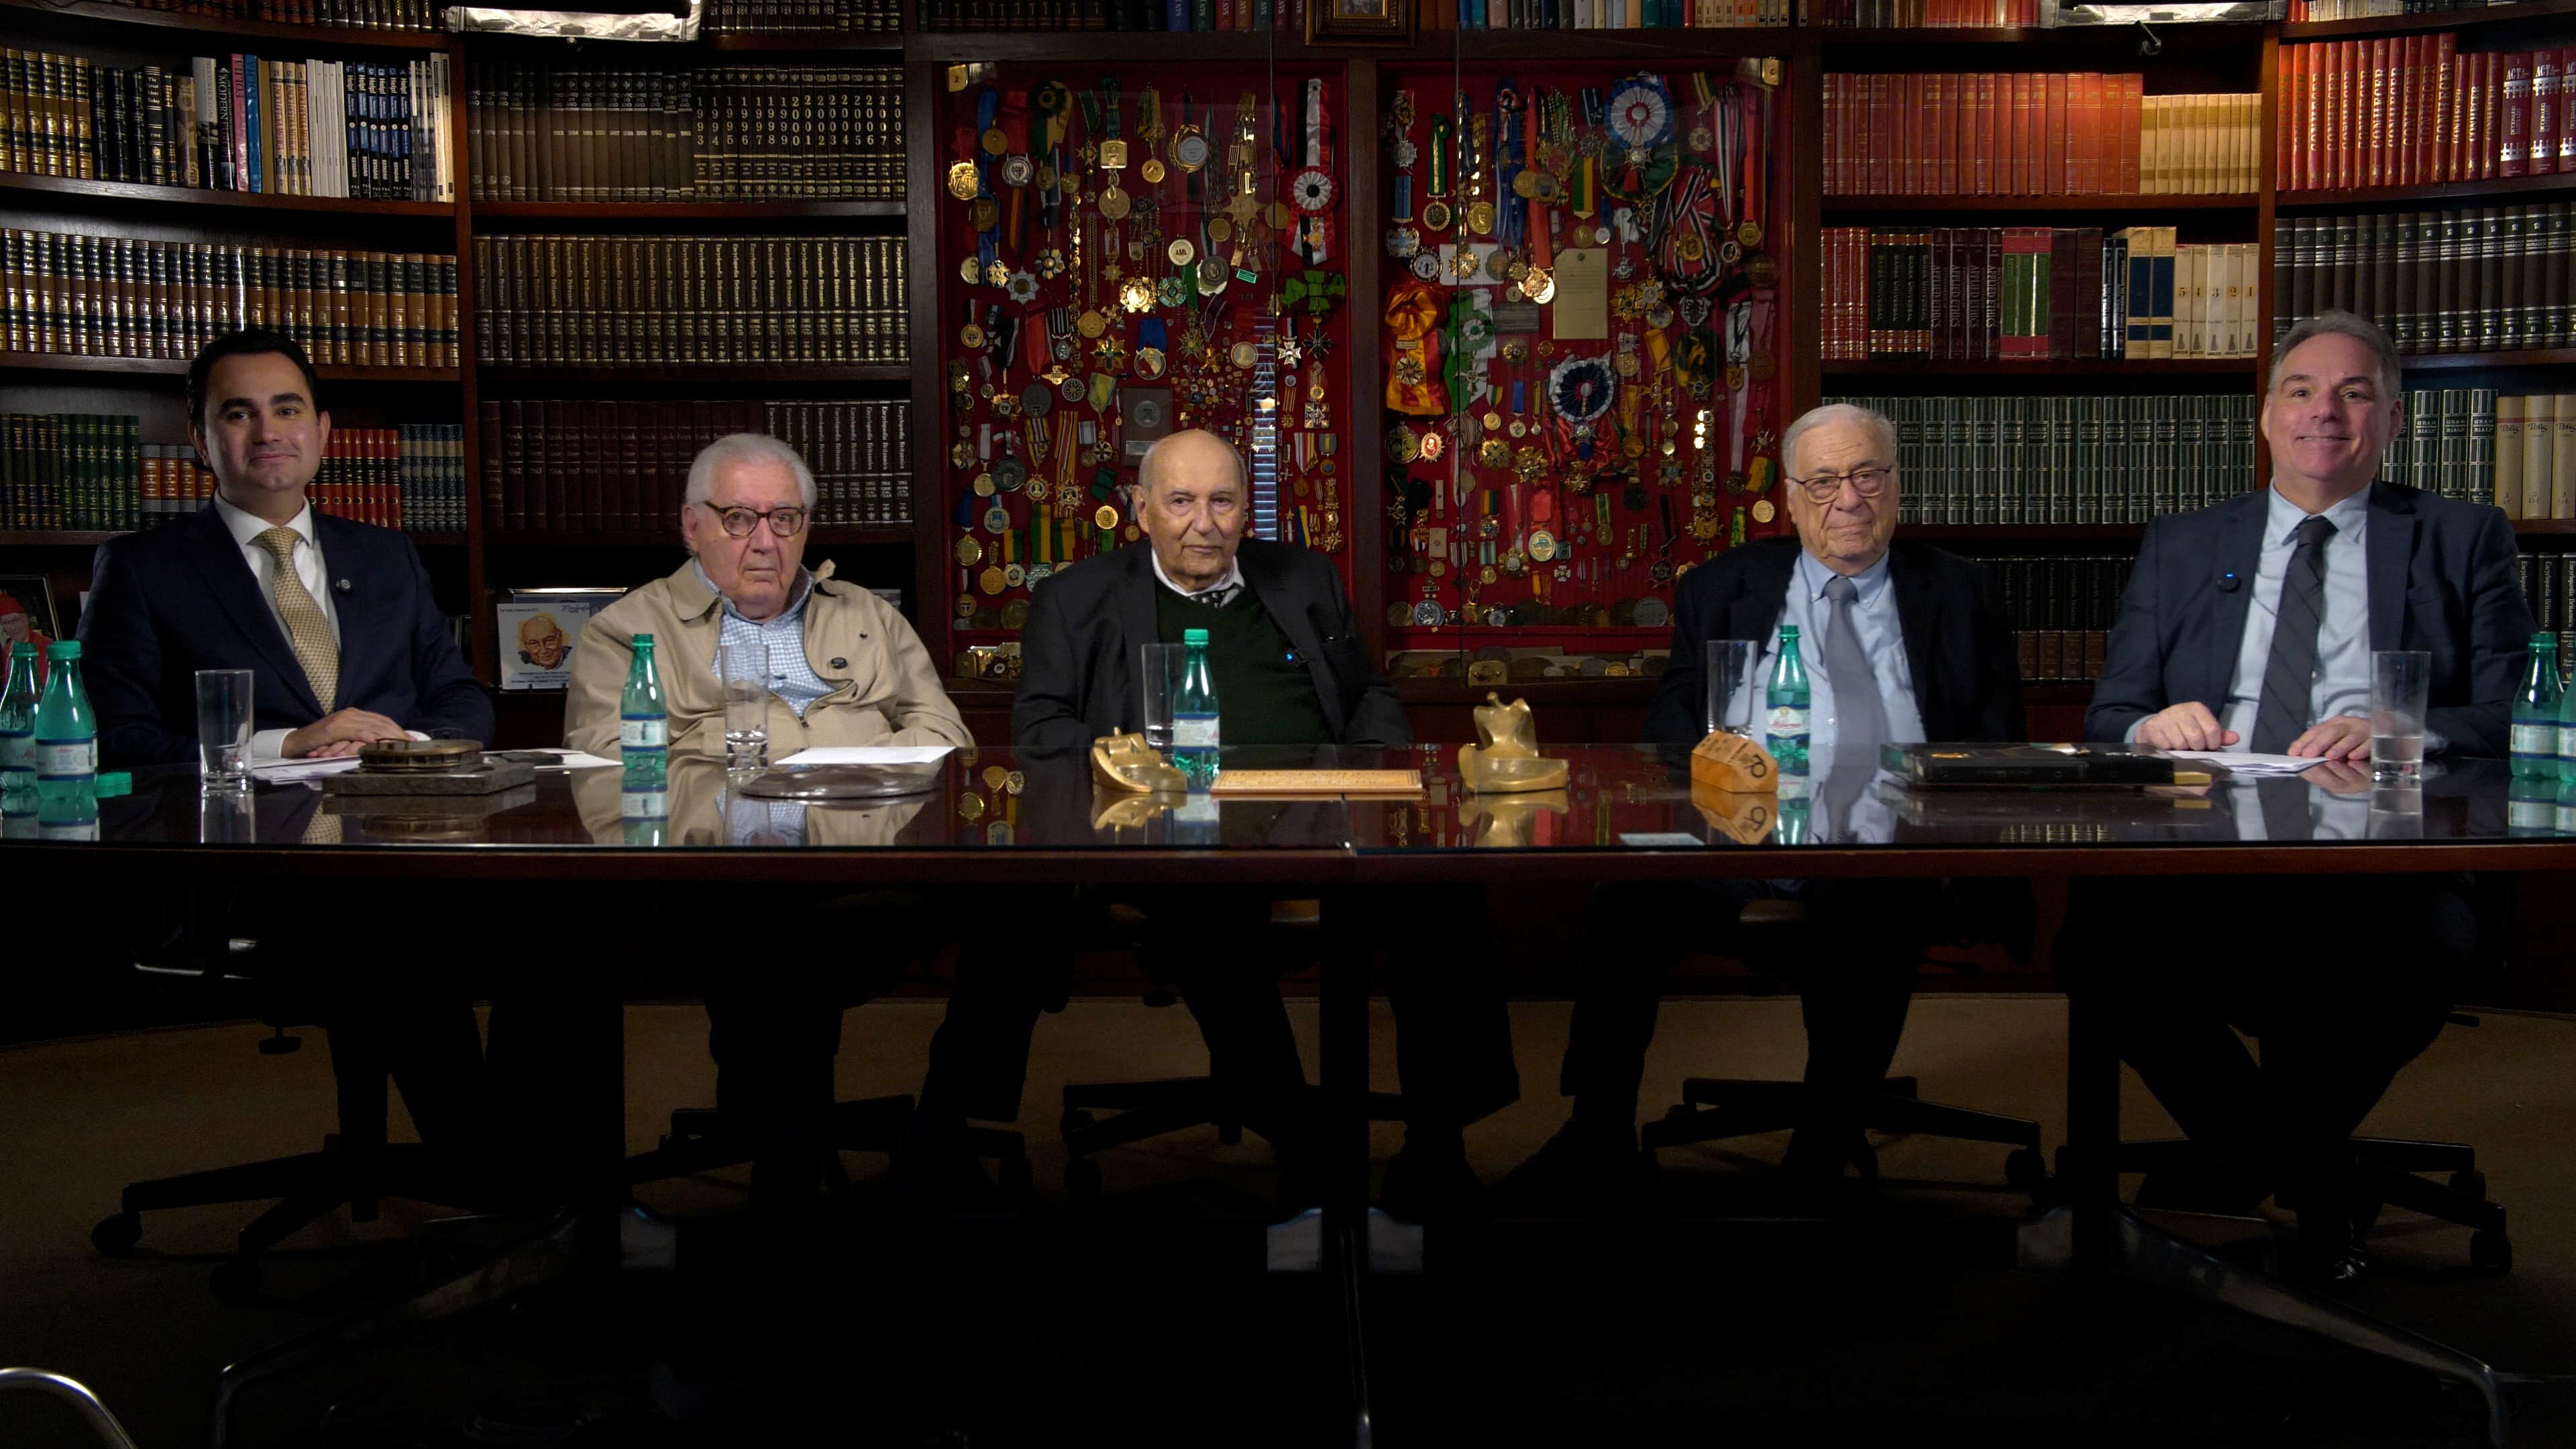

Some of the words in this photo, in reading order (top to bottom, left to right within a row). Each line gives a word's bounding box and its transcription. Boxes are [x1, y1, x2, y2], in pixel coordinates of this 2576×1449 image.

[218, 75, 228, 119] MODERN
[2372, 68, 2385, 148] CONHECER
[2388, 68, 2401, 148] CONHECER
[2436, 62, 2452, 142] CONHECER
[2469, 87, 2479, 142] CONHECER
[2485, 86, 2496, 141] CONHECER
[1933, 266, 1942, 297] APPLIED
[1951, 265, 1961, 297] APPLIED
[1970, 266, 1979, 297] APPLIED
[1987, 265, 1996, 297] APPLIED
[2179, 288, 2185, 297] 5
[2195, 288, 2200, 297] 4
[2212, 288, 2218, 297] 3
[2230, 287, 2237, 297] 2
[2249, 287, 2252, 297] 1
[1933, 300, 1941, 327] ETHICS
[1950, 301, 1960, 327] ETHICS
[1970, 301, 1979, 327] ETHICS
[1986, 300, 1996, 327] ETHICS
